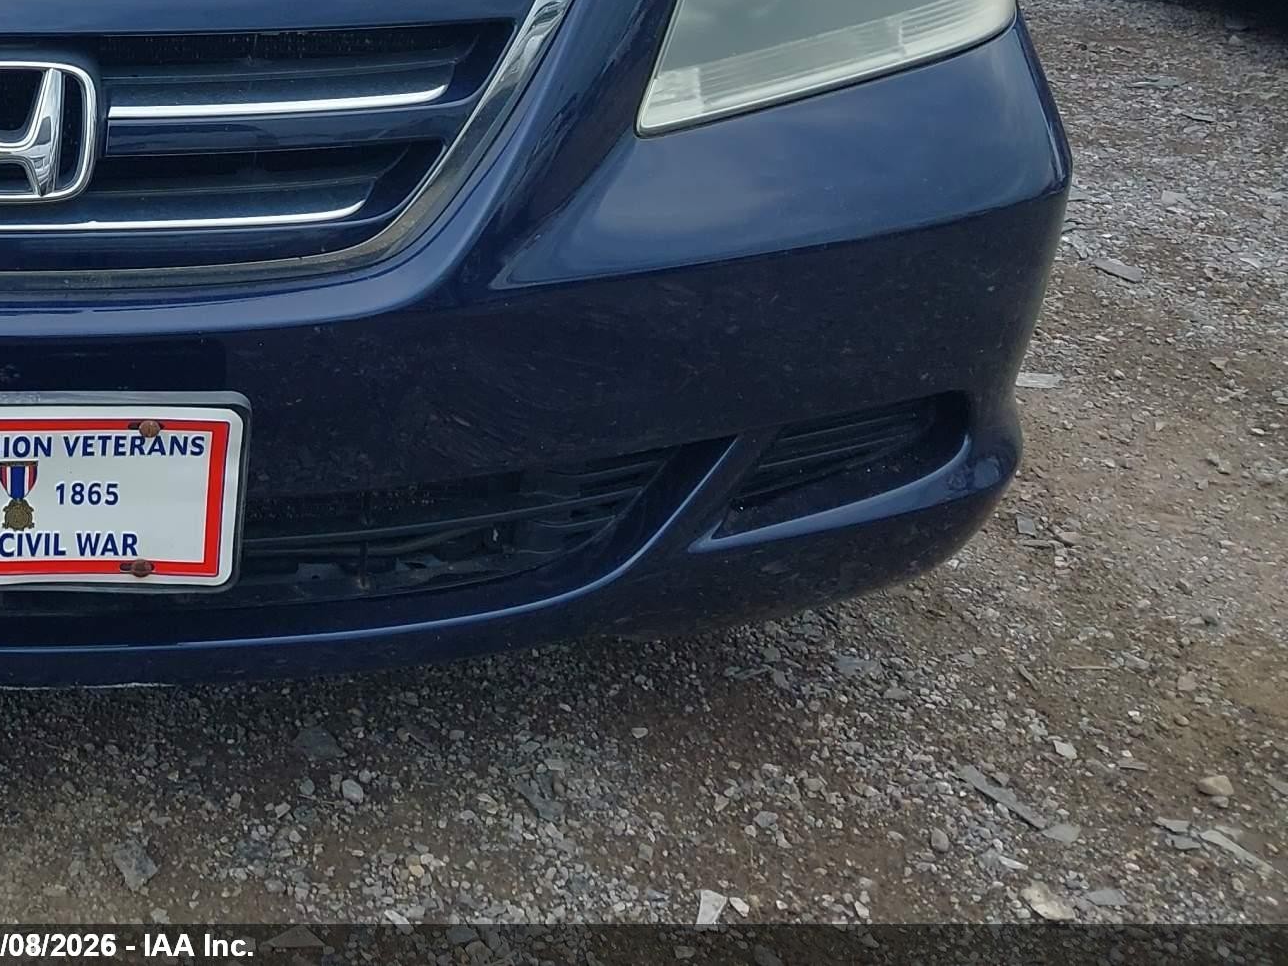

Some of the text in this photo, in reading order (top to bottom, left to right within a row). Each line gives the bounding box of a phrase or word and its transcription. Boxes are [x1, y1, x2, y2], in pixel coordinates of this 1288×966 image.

[64, 435, 206, 459] VETERANS
[55, 483, 121, 507] 1865
[76, 533, 139, 557] WAR
